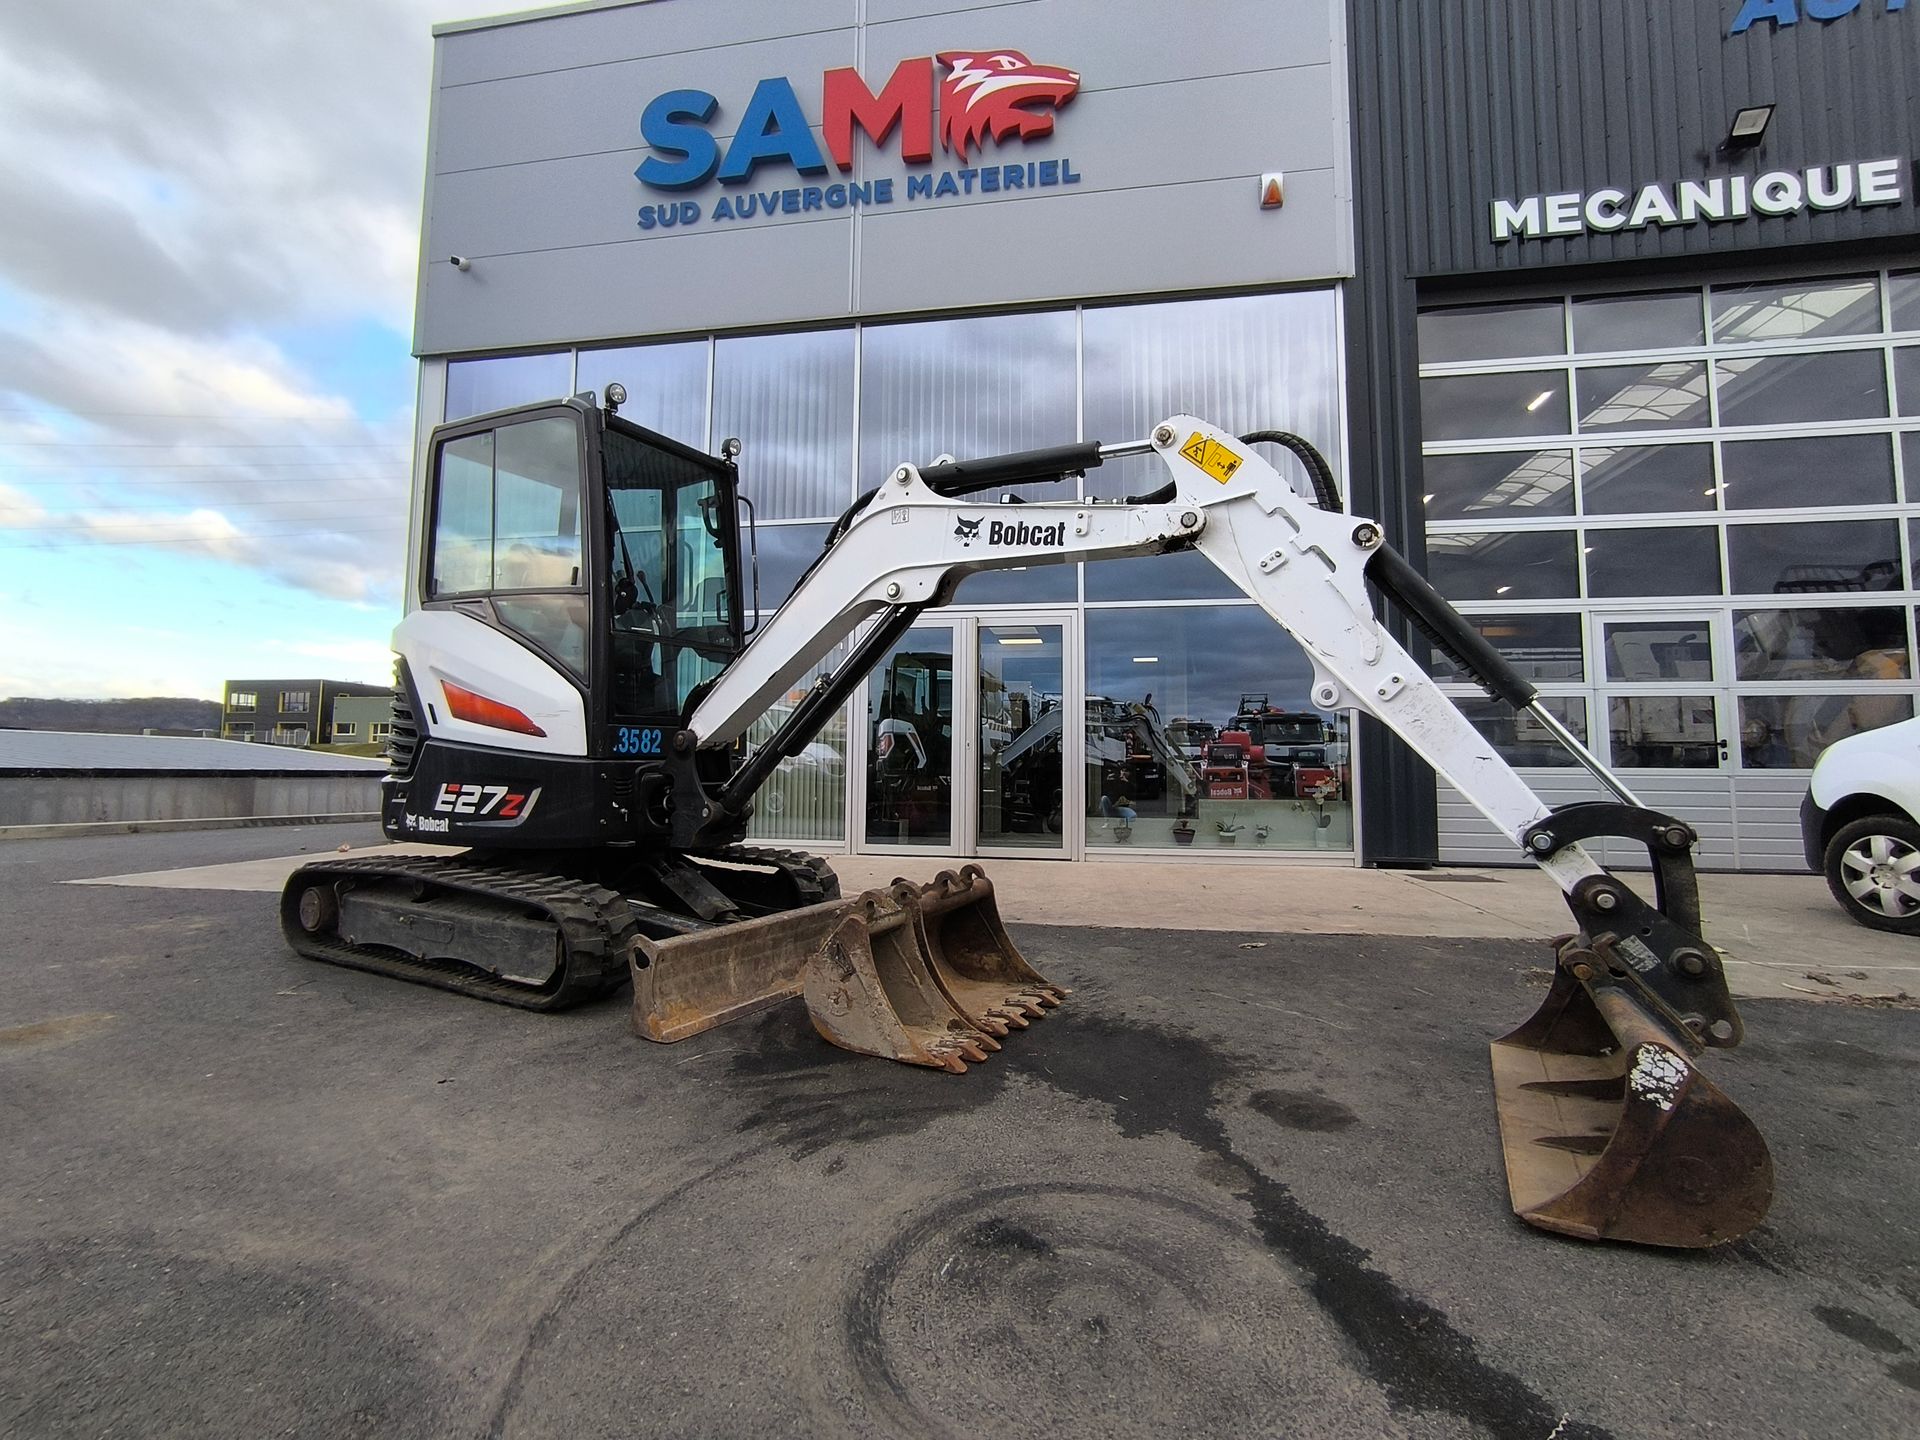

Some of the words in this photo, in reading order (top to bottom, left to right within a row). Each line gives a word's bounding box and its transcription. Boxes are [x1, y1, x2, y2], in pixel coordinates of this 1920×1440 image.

[634, 56, 933, 191] SAM
[637, 201, 700, 229] SUD
[712, 178, 893, 220] AUVERGNE
[907, 158, 1081, 199] MATERIEL
[1492, 159, 1900, 241] MECANIQUE
[989, 520, 1066, 547] Bobcat
[618, 727, 662, 754] 3582
[418, 815, 449, 832] Bobcat
